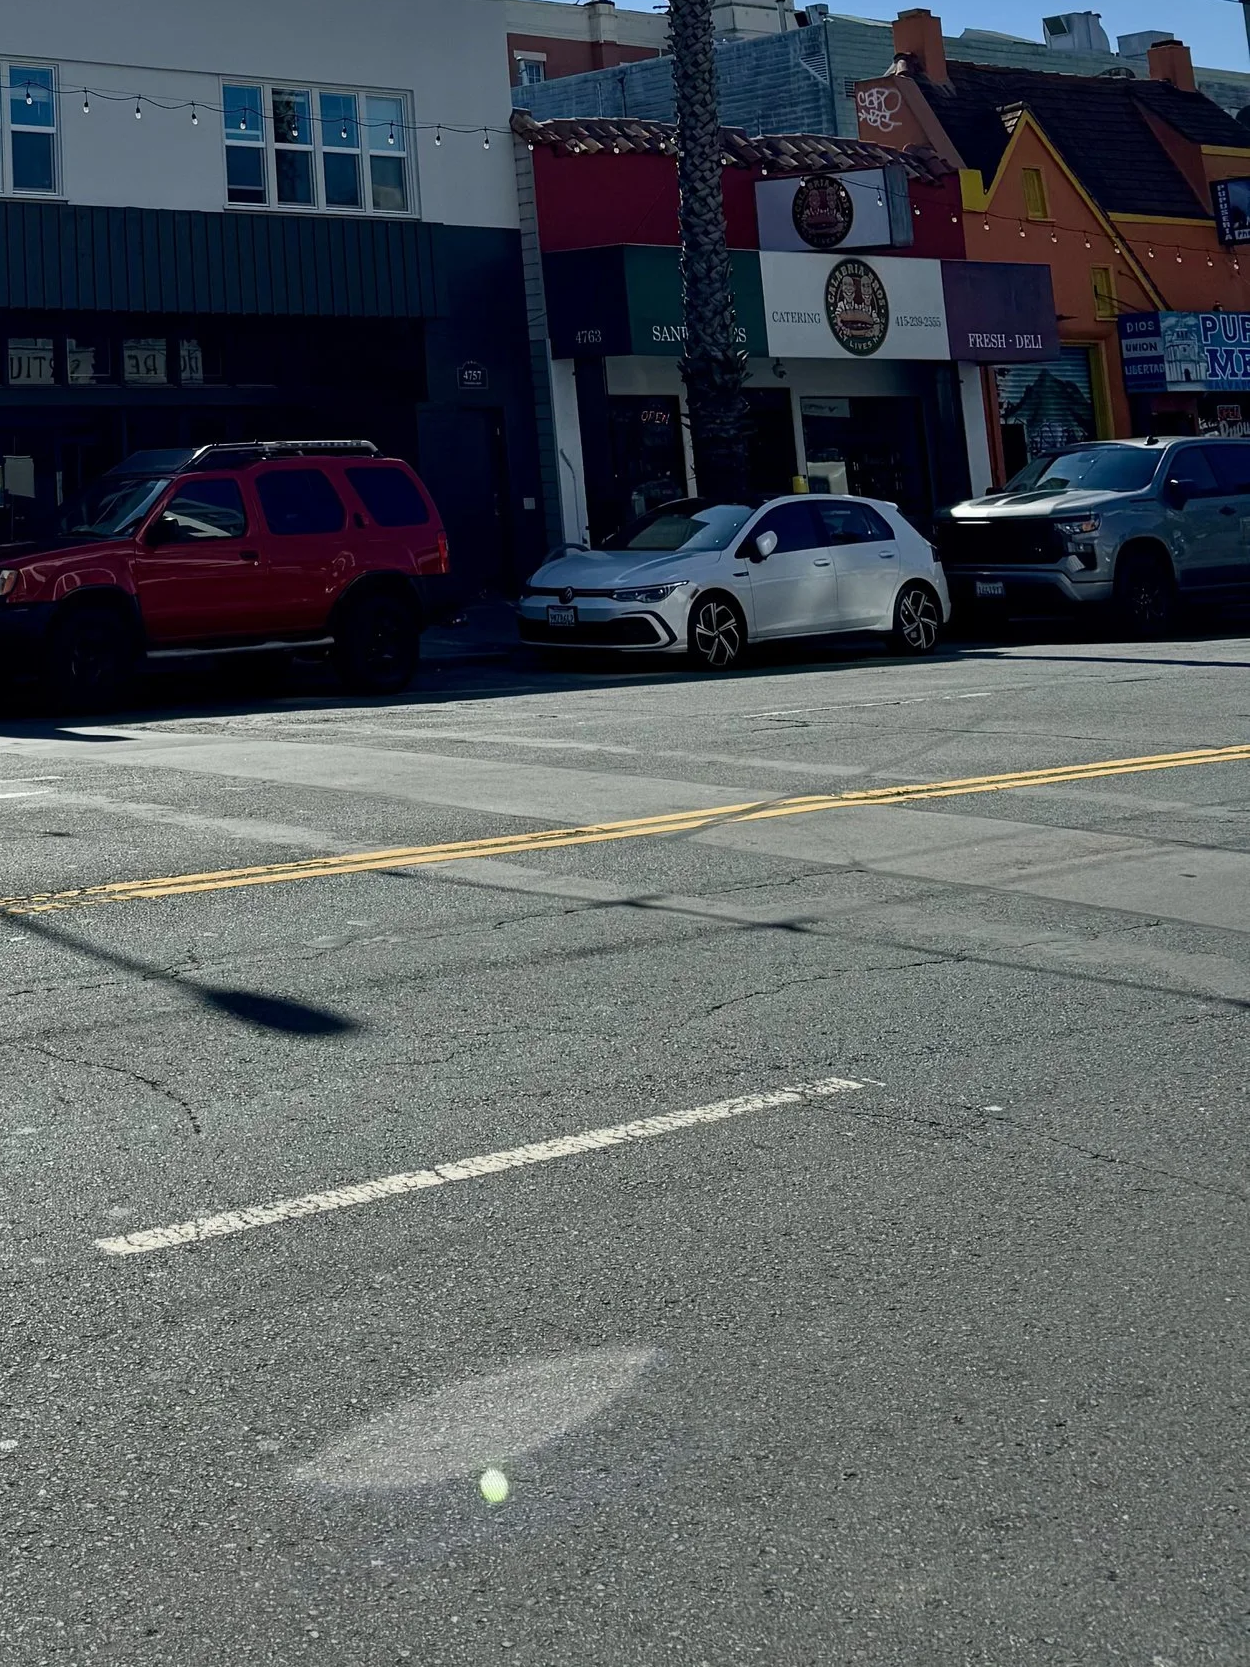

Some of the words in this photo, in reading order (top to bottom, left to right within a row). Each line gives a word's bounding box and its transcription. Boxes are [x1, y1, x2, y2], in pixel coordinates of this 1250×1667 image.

[827, 263, 865, 304] CALABRIA
[772, 310, 821, 324] CATERING
[894, 316, 942, 328] 415-239-2555
[1125, 320, 1155, 334] DIOS
[575, 329, 602, 344] 4763
[968, 333, 1007, 348] FRESH
[1014, 334, 1043, 349] DELI
[849, 339, 873, 350] LIVES
[1125, 341, 1158, 352] UNION
[463, 370, 482, 381] 4757
[1124, 363, 1165, 375] LIBERTAD
[640, 410, 670, 425] OPEN
